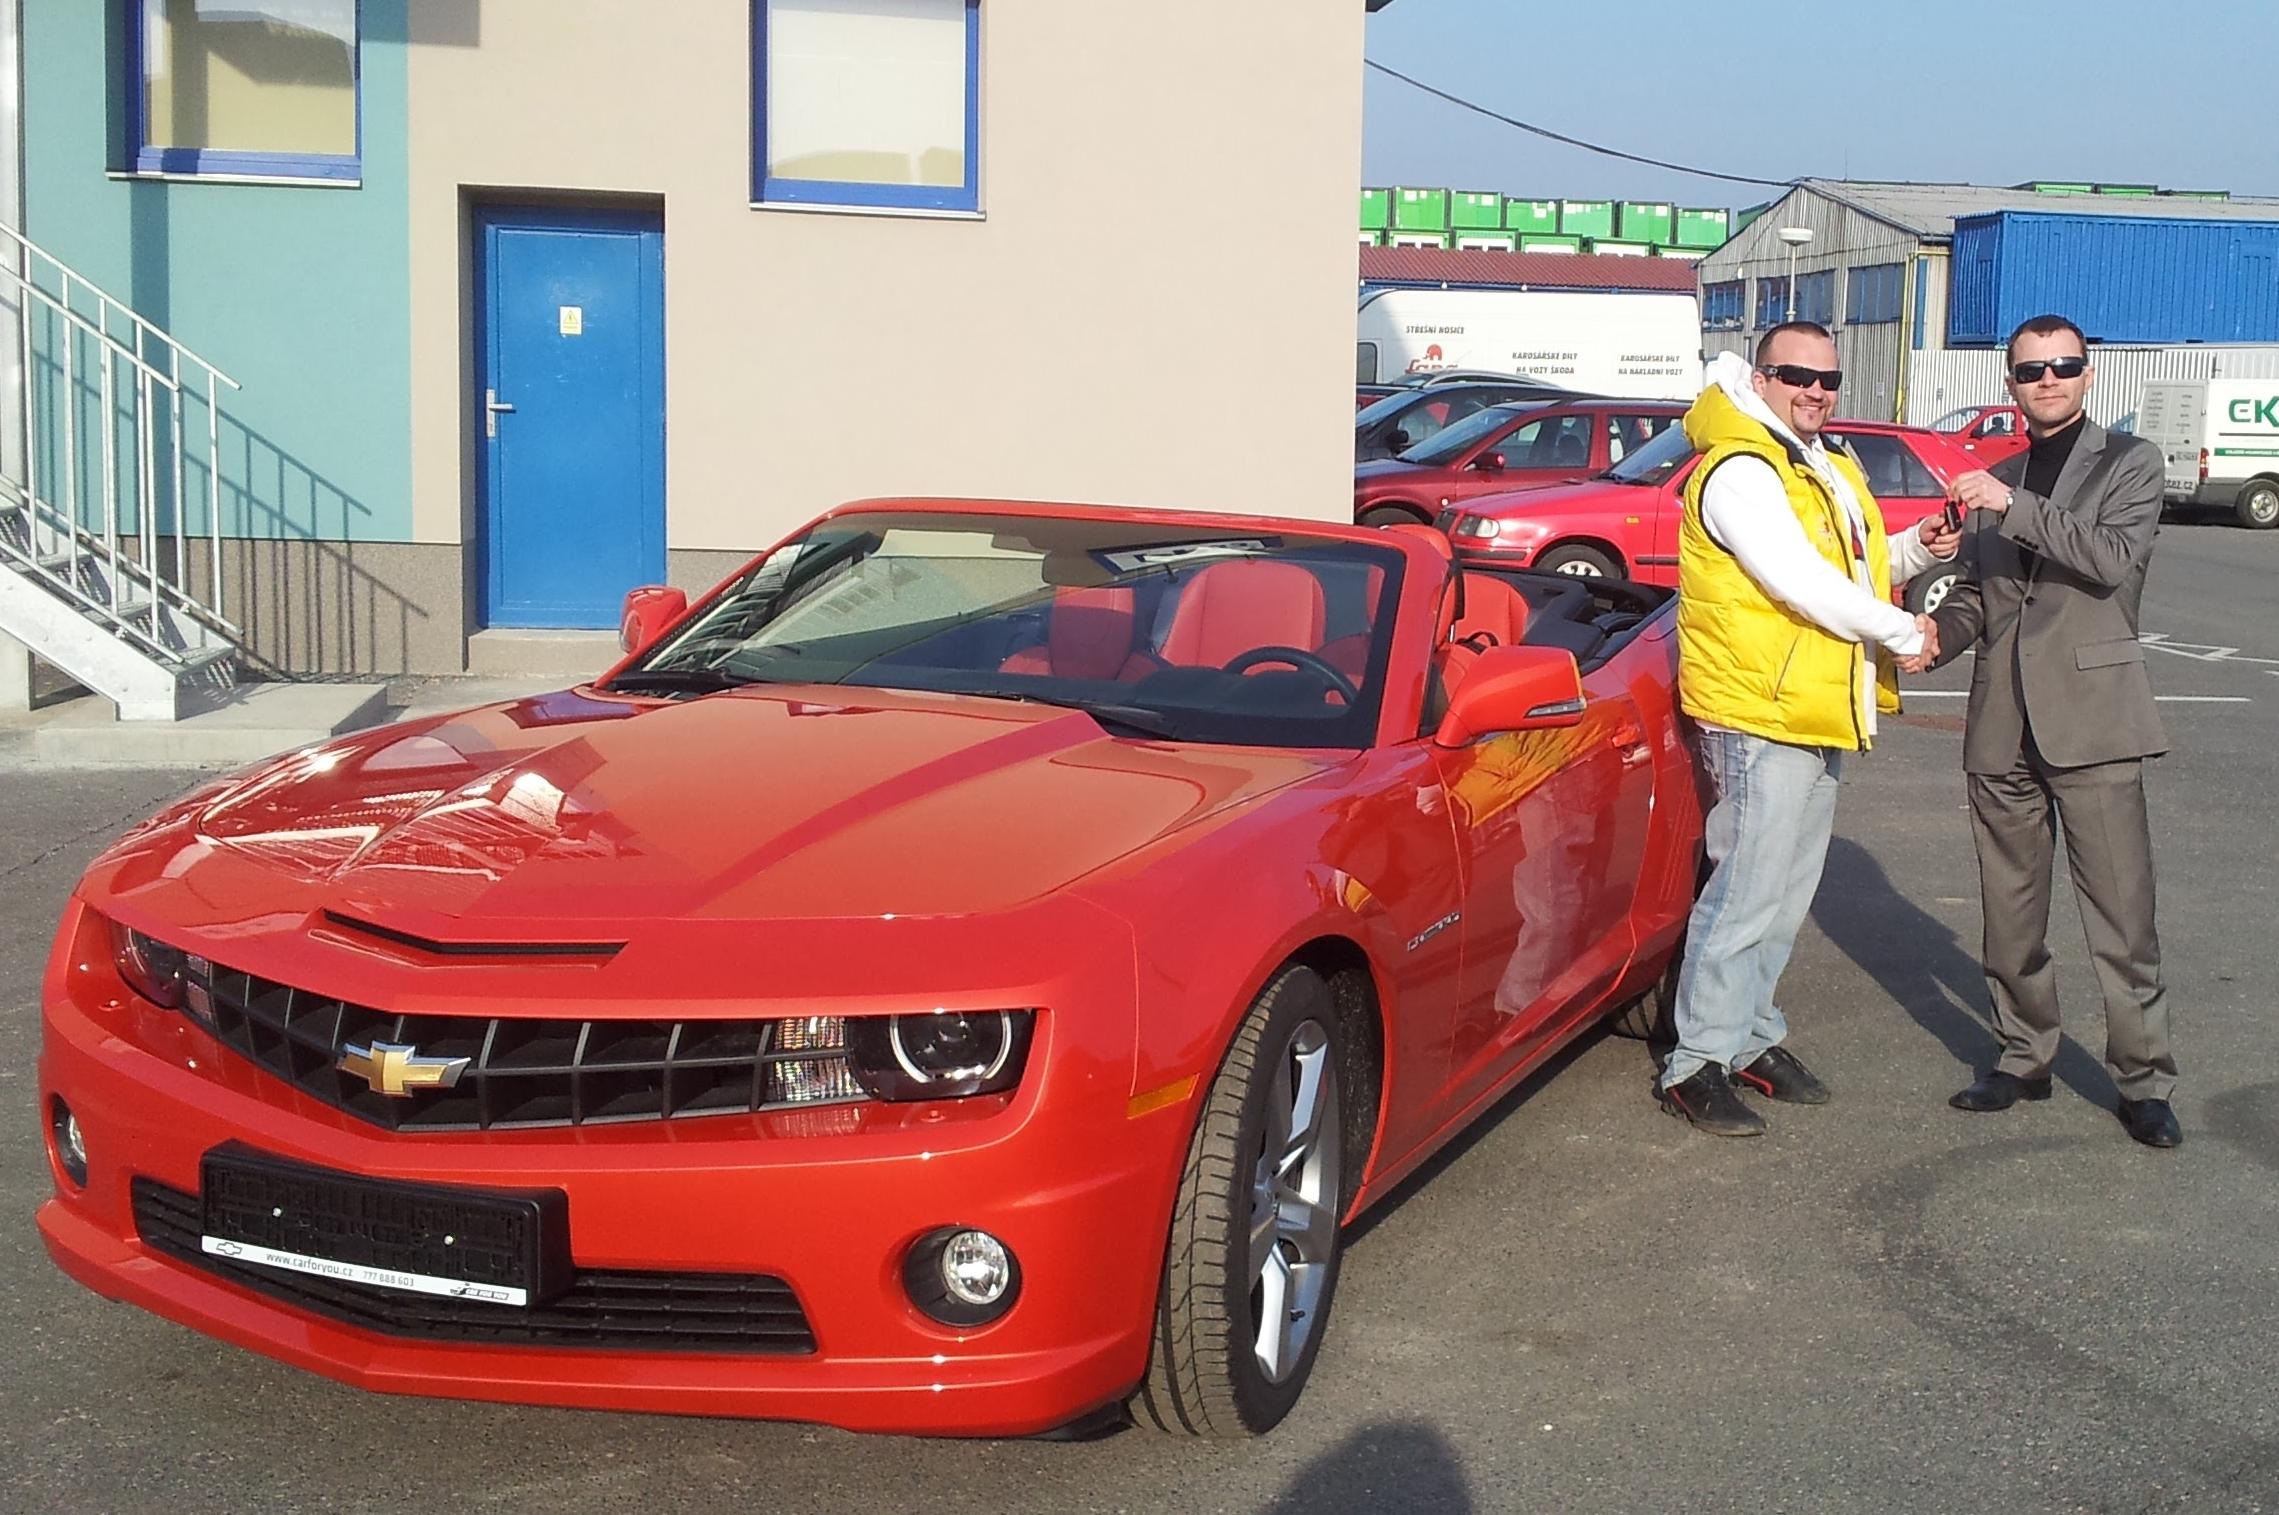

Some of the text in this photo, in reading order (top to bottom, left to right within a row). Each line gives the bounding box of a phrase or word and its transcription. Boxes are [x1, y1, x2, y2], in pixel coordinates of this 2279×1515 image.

[1516, 365, 1527, 374] NA
[1529, 366, 1548, 374] VOZY
[1618, 367, 1628, 375] NA
[1665, 368, 1684, 376] VOZY
[265, 1253, 414, 1287] www.carforyou.cz 777 888 603
